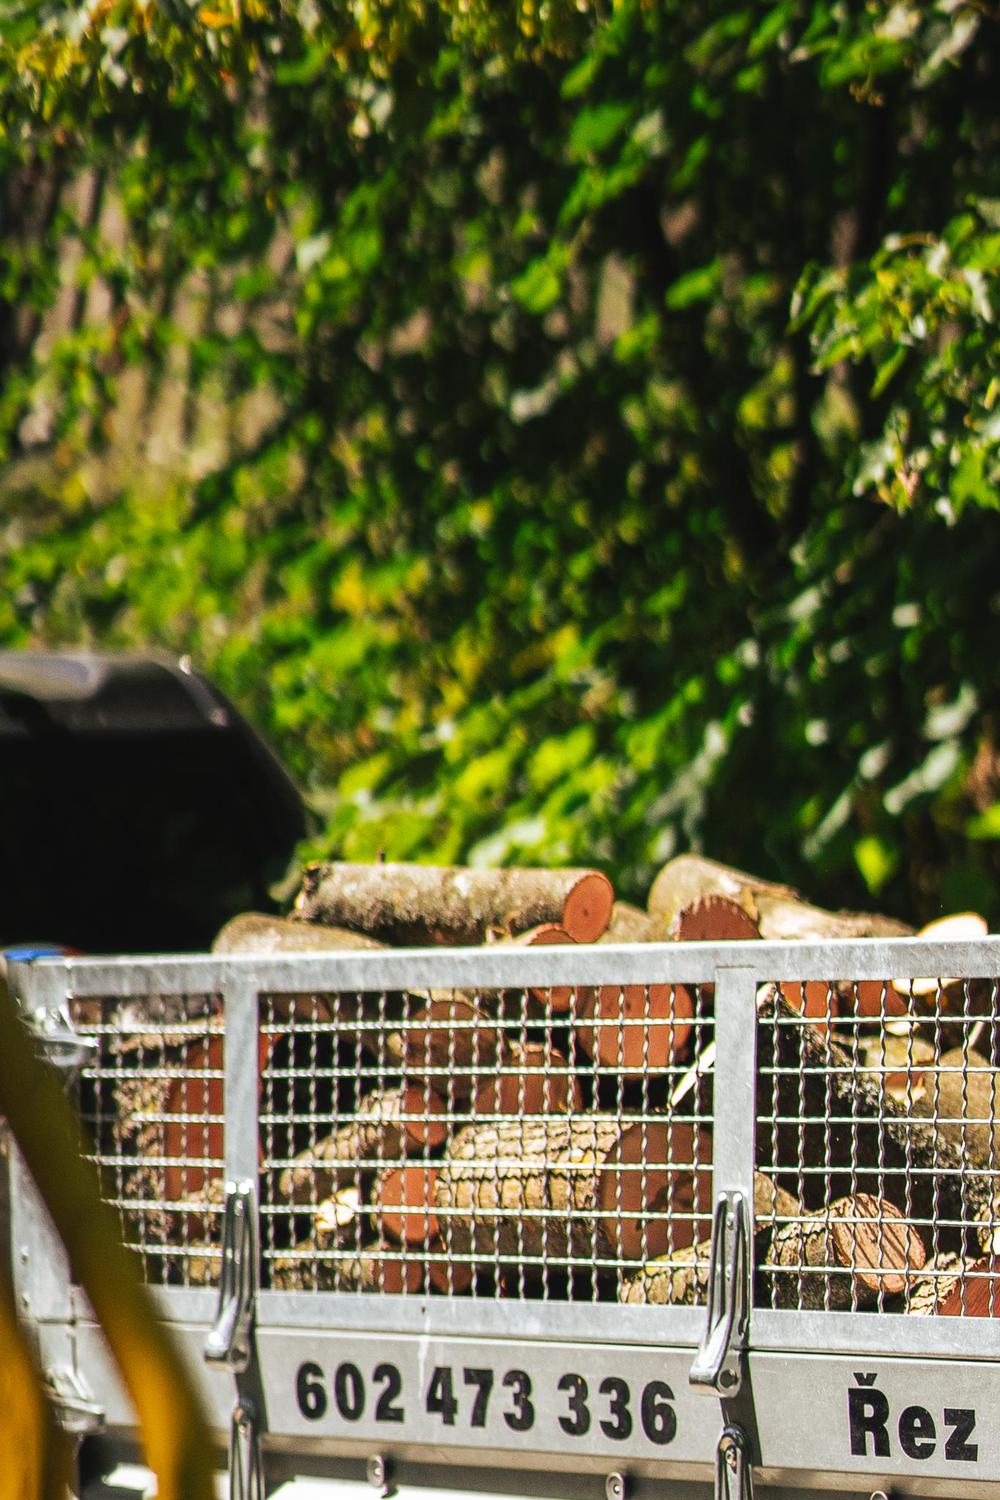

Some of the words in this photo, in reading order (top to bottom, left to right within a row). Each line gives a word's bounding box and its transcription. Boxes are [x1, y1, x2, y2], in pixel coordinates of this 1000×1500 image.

[297, 1361, 405, 1424] 602
[426, 1366, 536, 1431] 473
[557, 1373, 678, 1445] 336
[848, 1372, 979, 1462] Řez
